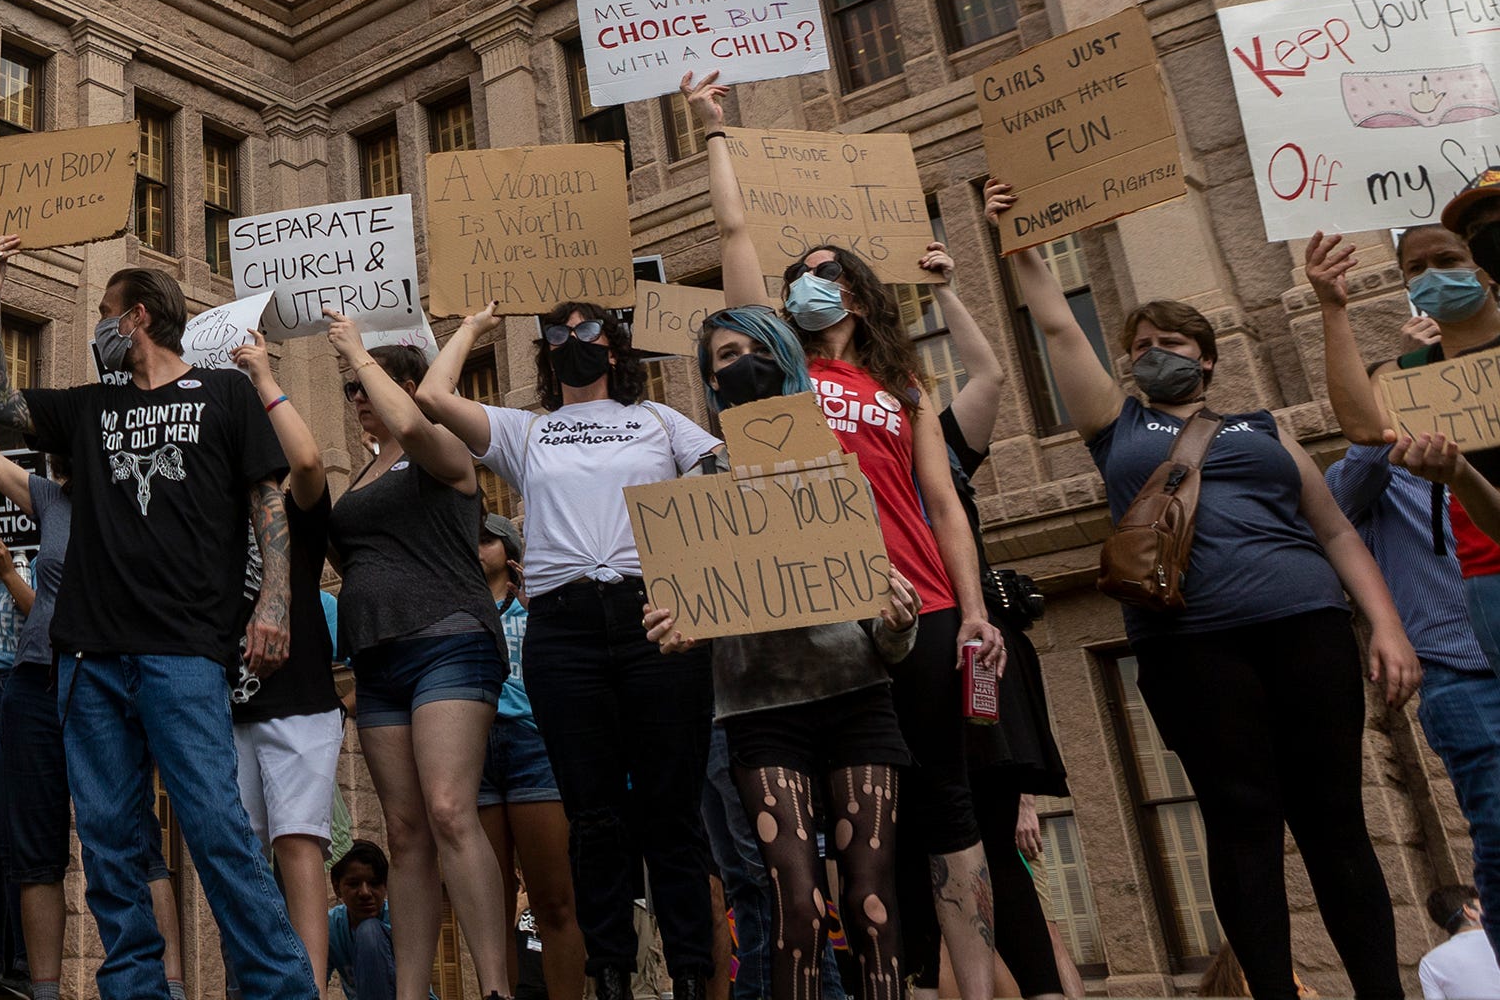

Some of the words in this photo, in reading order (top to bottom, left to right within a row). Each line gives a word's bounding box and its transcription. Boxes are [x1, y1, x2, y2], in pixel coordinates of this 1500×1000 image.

[594, 1, 640, 24] ME
[725, 2, 789, 28] BUT
[607, 50, 669, 76] WITH
[682, 46, 700, 61] A
[711, 20, 816, 59] CHILD?
[983, 64, 1046, 102] GIRLS
[1066, 32, 1122, 68] JUST
[1232, 17, 1355, 98] Keep
[1001, 99, 1067, 134] WANNA
[1077, 72, 1128, 105] HAVE
[761, 136, 831, 162] EPISODE
[842, 143, 868, 163] OF
[17, 158, 53, 192] MY
[61, 148, 116, 182] BODY
[434, 154, 475, 202] A
[476, 149, 598, 201] Woman
[792, 167, 820, 181] THE
[1102, 164, 1176, 201] RIGHTS!!
[1268, 142, 1343, 202] Off
[1366, 165, 1436, 219] my
[3, 205, 31, 236] MY
[458, 213, 485, 237] Is
[495, 200, 585, 236] Worth
[850, 184, 927, 223] TALE
[234, 207, 394, 251] SEPARATE
[244, 250, 355, 289] CHURCH
[364, 241, 385, 272] &
[472, 237, 536, 265] More
[540, 233, 598, 260] Than
[463, 271, 524, 308] HER
[1393, 372, 1430, 412] I
[101, 409, 118, 432] NO
[125, 403, 206, 429] COUNTRY
[102, 431, 124, 450] FOR
[131, 427, 156, 449] OLD
[165, 424, 199, 444] MEN
[1147, 422, 1180, 435] ONE
[637, 484, 768, 554] MIND
[650, 561, 750, 626] OWN
[757, 550, 892, 619] UTERUS
